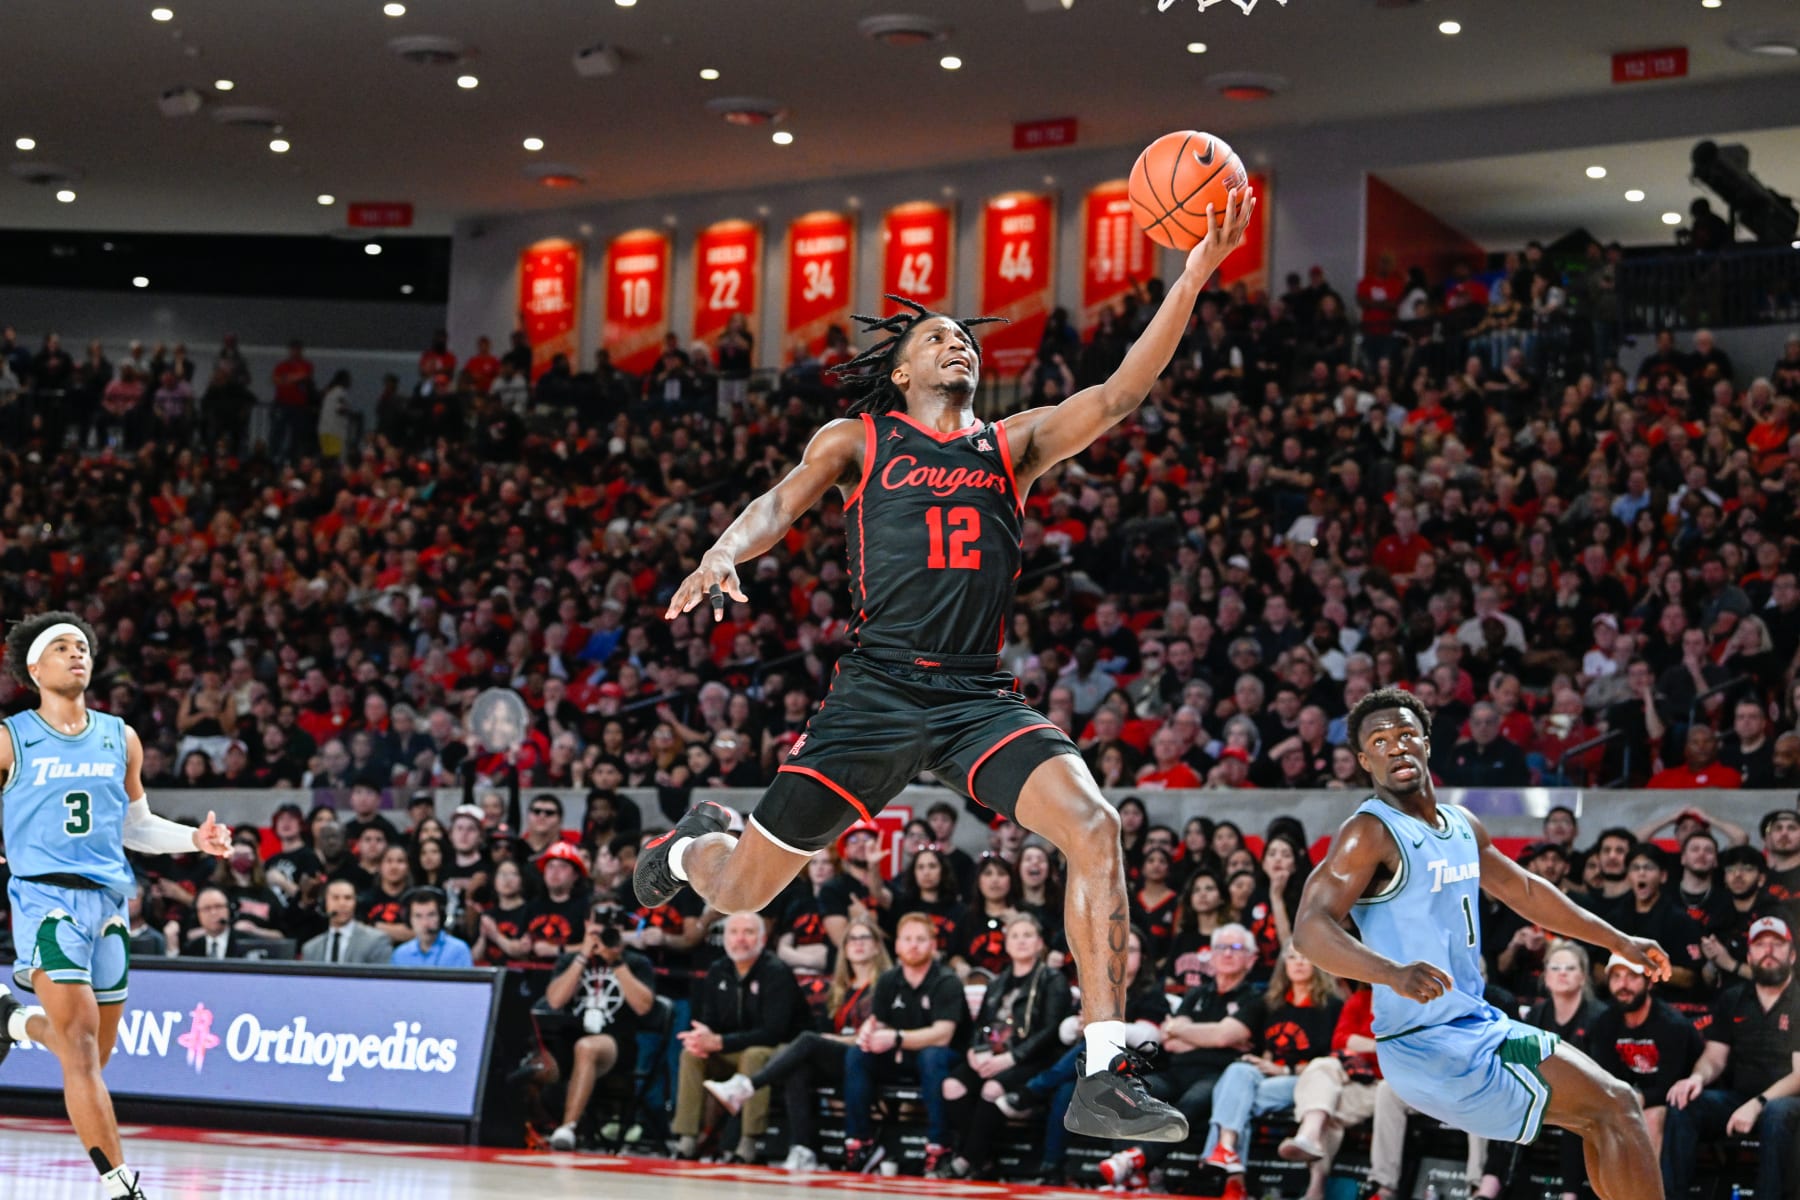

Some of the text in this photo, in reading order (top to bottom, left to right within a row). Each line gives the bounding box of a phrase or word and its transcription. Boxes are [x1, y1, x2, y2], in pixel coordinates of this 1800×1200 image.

[803, 260, 835, 301] 34
[899, 252, 934, 295] 42
[999, 240, 1033, 283] 44
[621, 277, 651, 317] 10
[709, 268, 740, 309] 22
[881, 454, 1006, 497] Cougars
[925, 506, 982, 570] 12
[63, 790, 92, 837] 3
[1462, 894, 1476, 947] 1
[226, 1013, 458, 1082] Orthopedics
